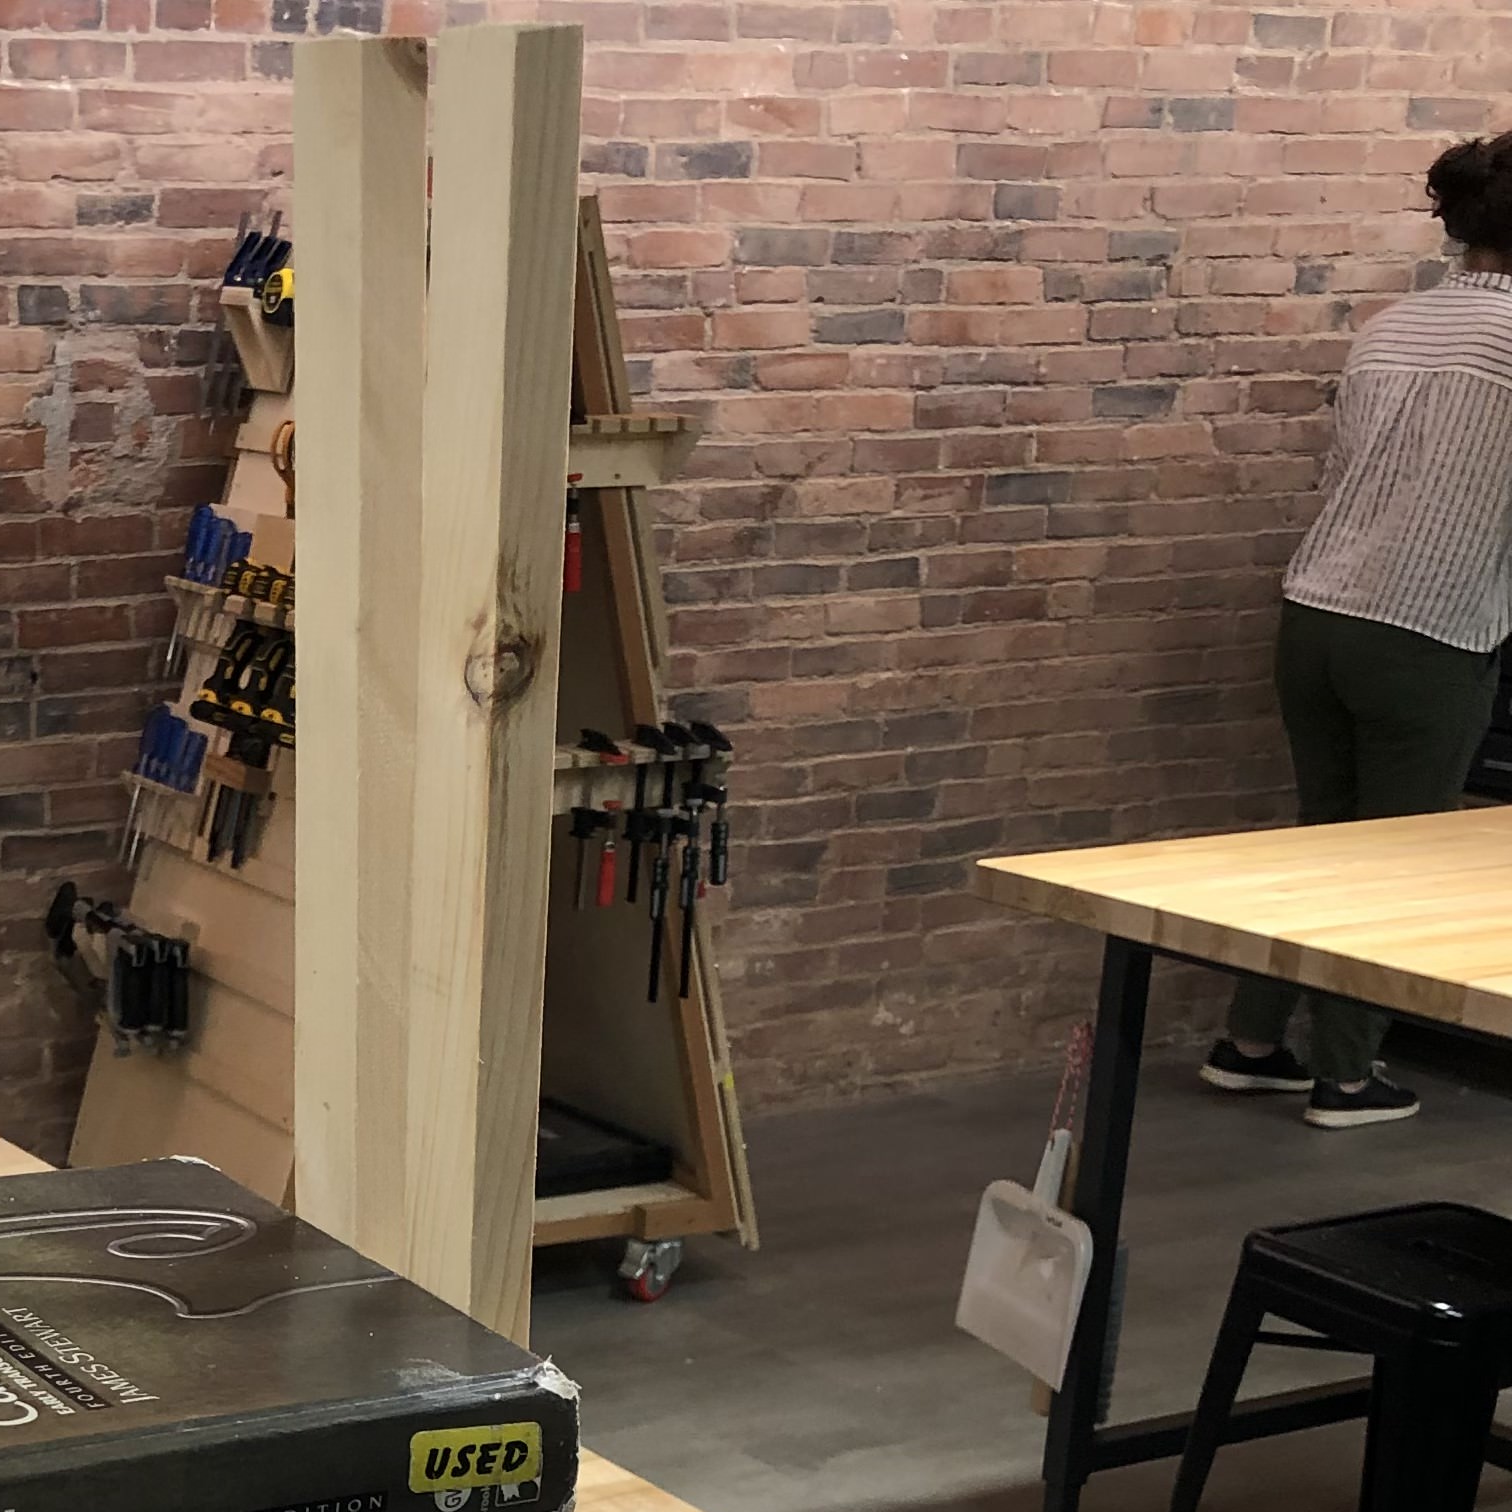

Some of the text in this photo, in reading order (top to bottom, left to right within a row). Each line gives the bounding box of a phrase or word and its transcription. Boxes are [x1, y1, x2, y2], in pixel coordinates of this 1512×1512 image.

[2, 1307, 160, 1404] JAMES STEWART
[28, 1390, 77, 1415] EARLY
[34, 1364, 105, 1409] FOURTH
[425, 1440, 529, 1480] USED
